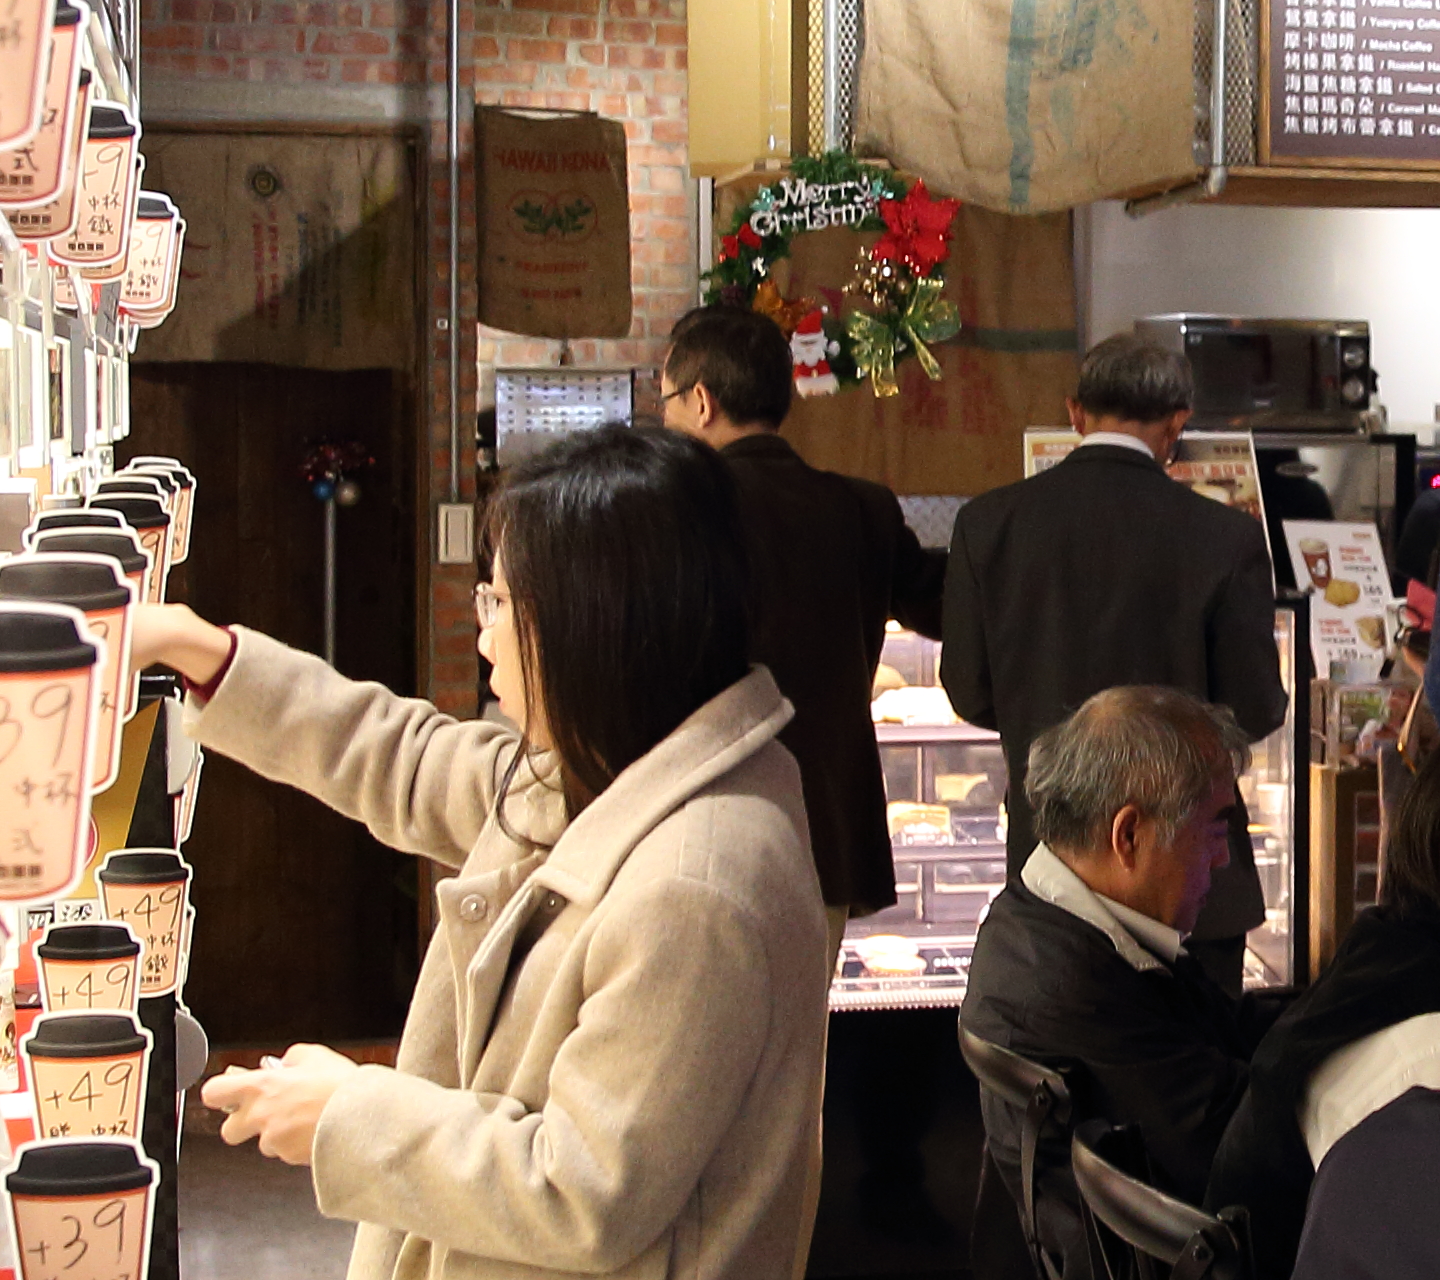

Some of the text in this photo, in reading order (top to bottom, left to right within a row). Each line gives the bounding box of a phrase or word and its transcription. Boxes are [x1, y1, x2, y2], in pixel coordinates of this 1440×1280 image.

[780, 173, 871, 207] Merry
[114, 885, 181, 929] +49
[53, 963, 130, 1009] +49
[45, 1062, 133, 1115] +49
[28, 1199, 126, 1269] +39
